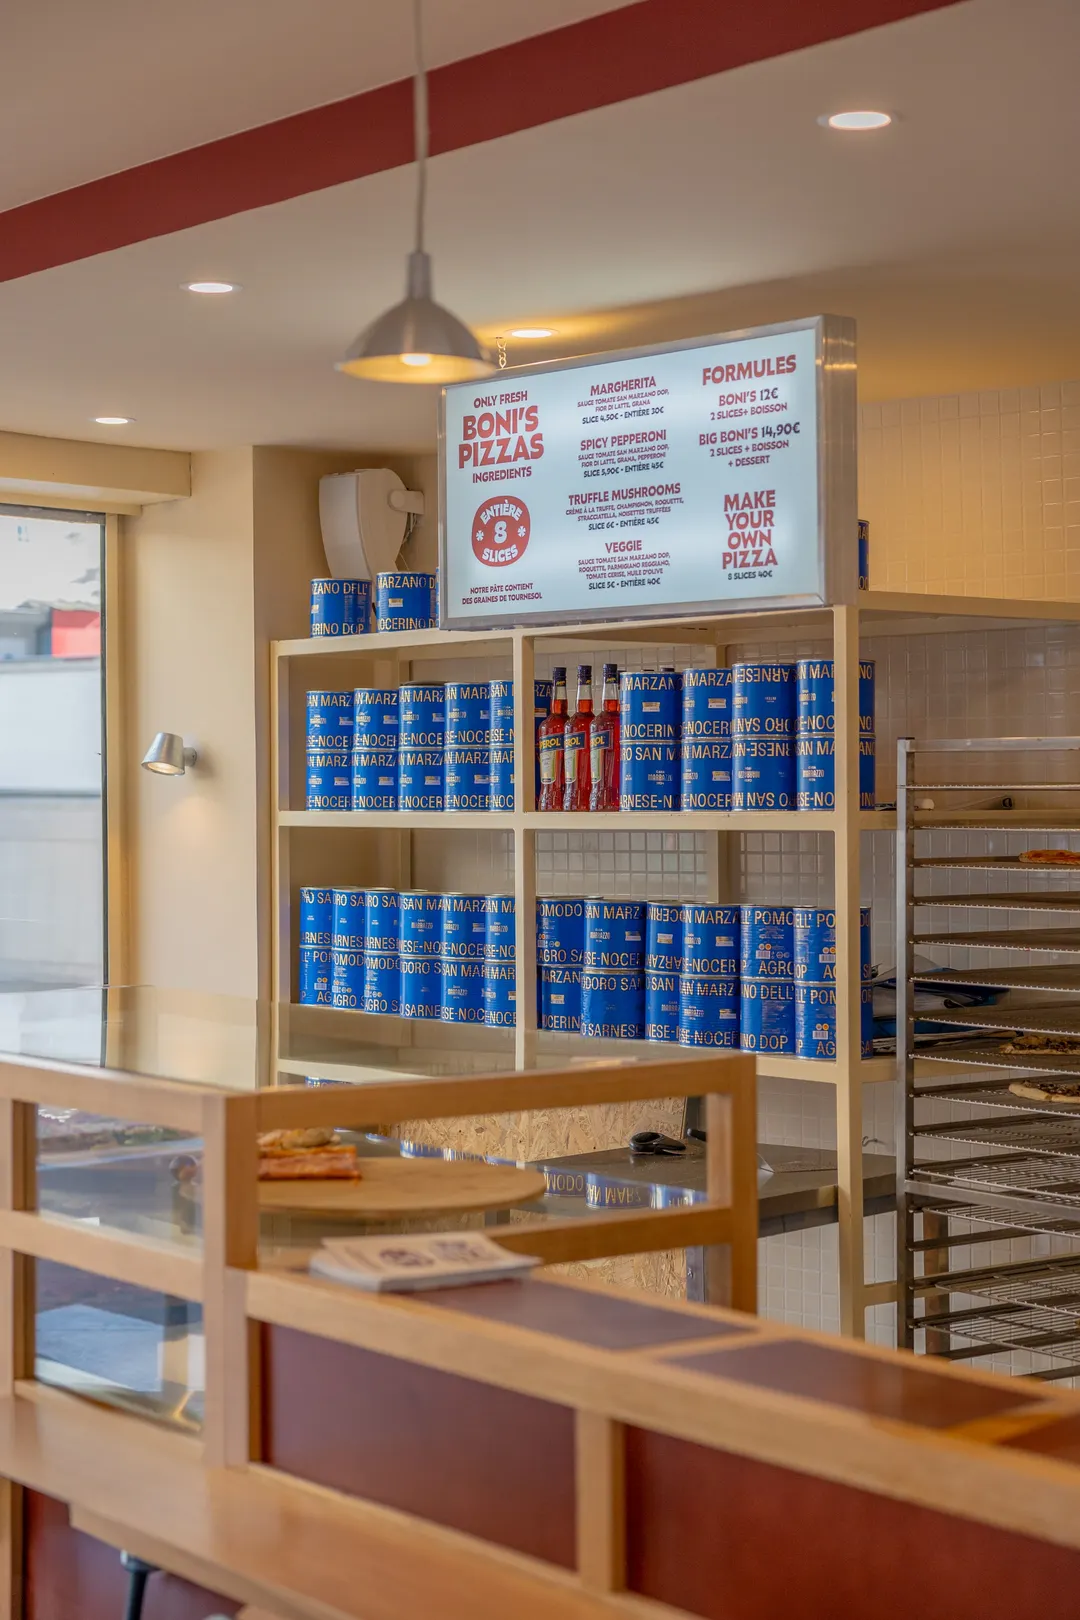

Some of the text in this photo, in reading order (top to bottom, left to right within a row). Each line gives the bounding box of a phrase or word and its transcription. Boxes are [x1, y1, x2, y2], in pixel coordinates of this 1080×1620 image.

[702, 354, 796, 385] FORMULES
[590, 376, 656, 396] MARGHERITA
[473, 390, 527, 408] ONLY FRESH
[719, 387, 778, 406] BONI'S 12€
[582, 406, 663, 424] SLICE 4,50€ ENTIÈRE 30€
[710, 412, 715, 420] 2
[750, 402, 787, 415] BOISSON
[462, 405, 538, 440] BONI'S
[580, 429, 666, 450] SPICY PEPPERONI
[699, 421, 800, 445] BIG BONI'S 14,90€
[458, 433, 544, 468] PIZZAS
[710, 448, 714, 456] 2
[716, 445, 742, 456] SLICES
[751, 439, 788, 451] BOISSON
[735, 454, 769, 466] DESSERT
[472, 466, 531, 483] INGREDIENTS
[583, 469, 600, 477] SLICE
[601, 466, 619, 476] 5,90€
[625, 462, 649, 472] ENTIÈRE
[568, 482, 680, 505] TRUFFLE MUSHROOMS
[724, 489, 775, 511] MAKE
[480, 499, 524, 524] ENTIÈRE
[725, 509, 774, 530] YOUR
[588, 522, 604, 530] SLICE
[620, 517, 645, 527] ENTIÈRE
[494, 521, 507, 544] 8
[727, 529, 771, 549] OWN
[482, 544, 518, 563] SLICES
[605, 540, 641, 553] VEGGIE
[722, 548, 778, 569] PIZZA
[620, 577, 645, 587] ENTIÈRE
[734, 571, 756, 579] SLICES
[490, 584, 503, 592] PÂTE
[504, 582, 533, 591] CONTIENT
[508, 592, 542, 600] TOURNESOL
[342, 623, 363, 635] DOP
[737, 718, 761, 732] SAN
[635, 747, 661, 760] SAN
[747, 792, 774, 806] SAN
[403, 898, 422, 910] SAN
[652, 977, 674, 991] SAN
[333, 994, 356, 1006] AGRO
[760, 1036, 788, 1050] DOP
